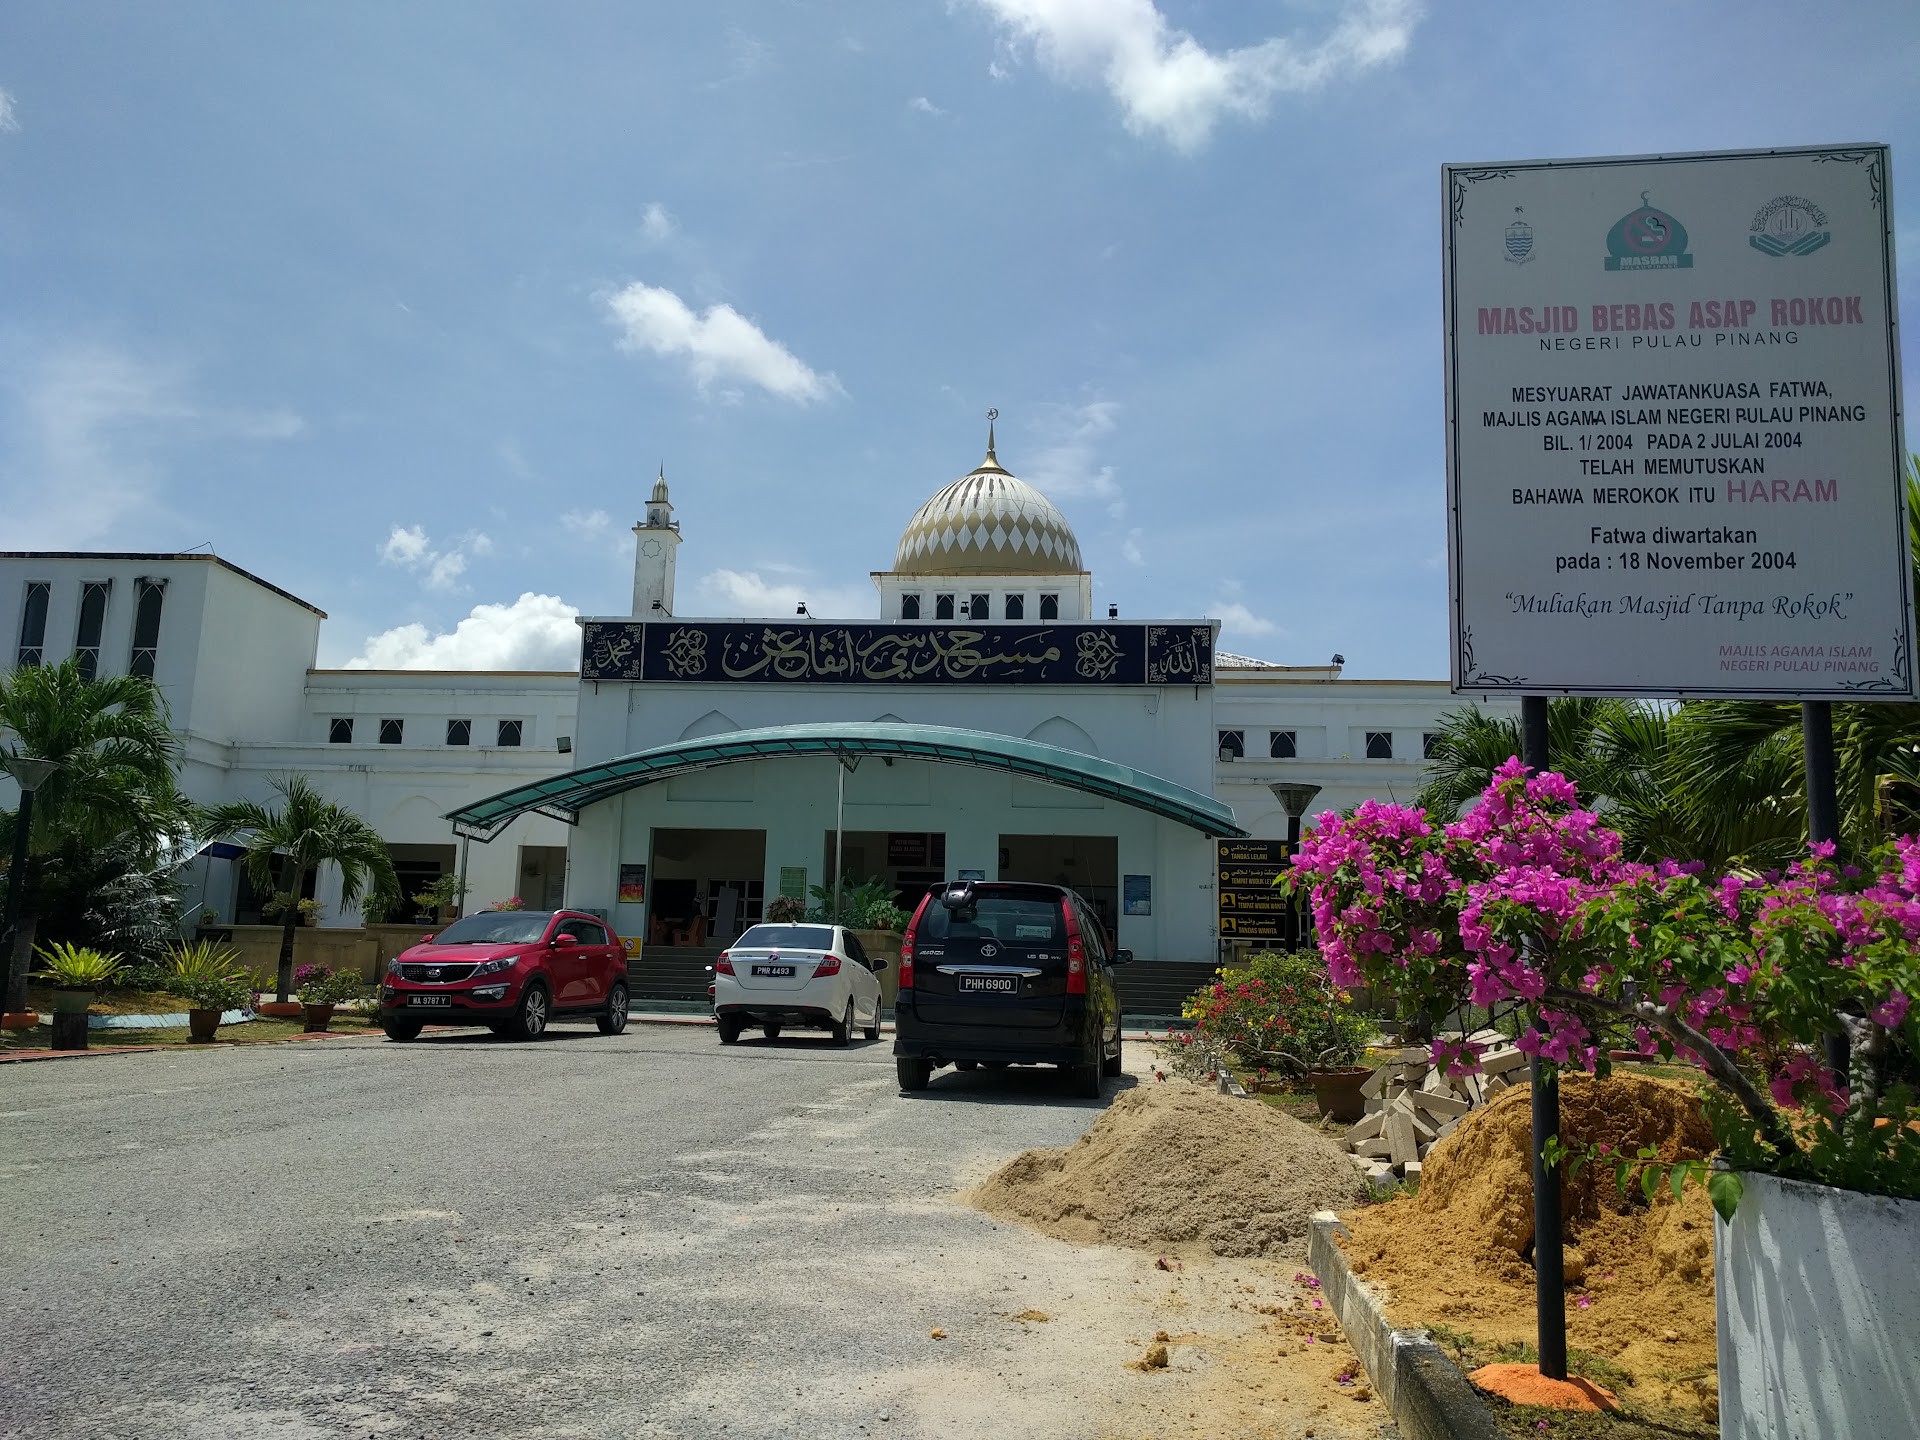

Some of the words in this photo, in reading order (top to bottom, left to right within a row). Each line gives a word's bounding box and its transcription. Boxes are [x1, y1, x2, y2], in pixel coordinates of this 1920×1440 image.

[1477, 306, 1578, 335] MASJID
[1592, 302, 1676, 332] BEBAS
[1688, 299, 1756, 329] ASAP
[1770, 296, 1864, 326] ROKOK
[1540, 336, 1619, 351] NEGERI
[1632, 334, 1701, 348] PULAU
[1715, 331, 1798, 346] PINANG
[1512, 386, 1612, 403] MESYUARAT
[1622, 383, 1760, 401] JAWATANKUASA
[1770, 381, 1833, 399] FATWA,
[1483, 411, 1541, 427] MAJLIS
[1545, 410, 1607, 426] AGAMA
[1611, 409, 1661, 425] ISLAM
[1667, 408, 1730, 424] NEGERI
[1736, 407, 1793, 423] PULAU
[1799, 405, 1866, 422] PINANG
[1543, 435, 1573, 451] BIL.
[1596, 434, 1633, 450] 2004
[1647, 433, 1693, 450] PADA
[1697, 433, 1706, 449] 2
[1711, 432, 1759, 449] JULAI
[1764, 432, 1803, 448] 2004
[1579, 459, 1634, 475] TELAH
[1644, 458, 1765, 475] MEMUTUSKAN
[1512, 488, 1584, 504] BAHAWA
[1593, 487, 1680, 504] MEROKOK
[1689, 487, 1716, 503] ITU
[1727, 479, 1838, 503] HARAM
[1591, 526, 1646, 544] Fatwa
[1652, 526, 1757, 544] diwartakan
[1556, 552, 1601, 573] pada
[1619, 552, 1640, 569] 18
[1647, 552, 1745, 569] November
[1751, 552, 1797, 569] 2004
[1619, 592, 1696, 621] Masjid
[1697, 594, 1765, 621] Tanpa
[1719, 645, 1767, 657] MAJLIS
[1770, 645, 1825, 657] AGAMA
[1828, 646, 1872, 658] ISLAM
[1719, 660, 1770, 671] NEGERI
[1773, 660, 1820, 672] PULAU
[1823, 661, 1880, 673] PINANG
[757, 966, 771, 975] PMR
[771, 966, 790, 976] 4493
[965, 978, 985, 990] PHH
[985, 979, 1012, 991] 6900
